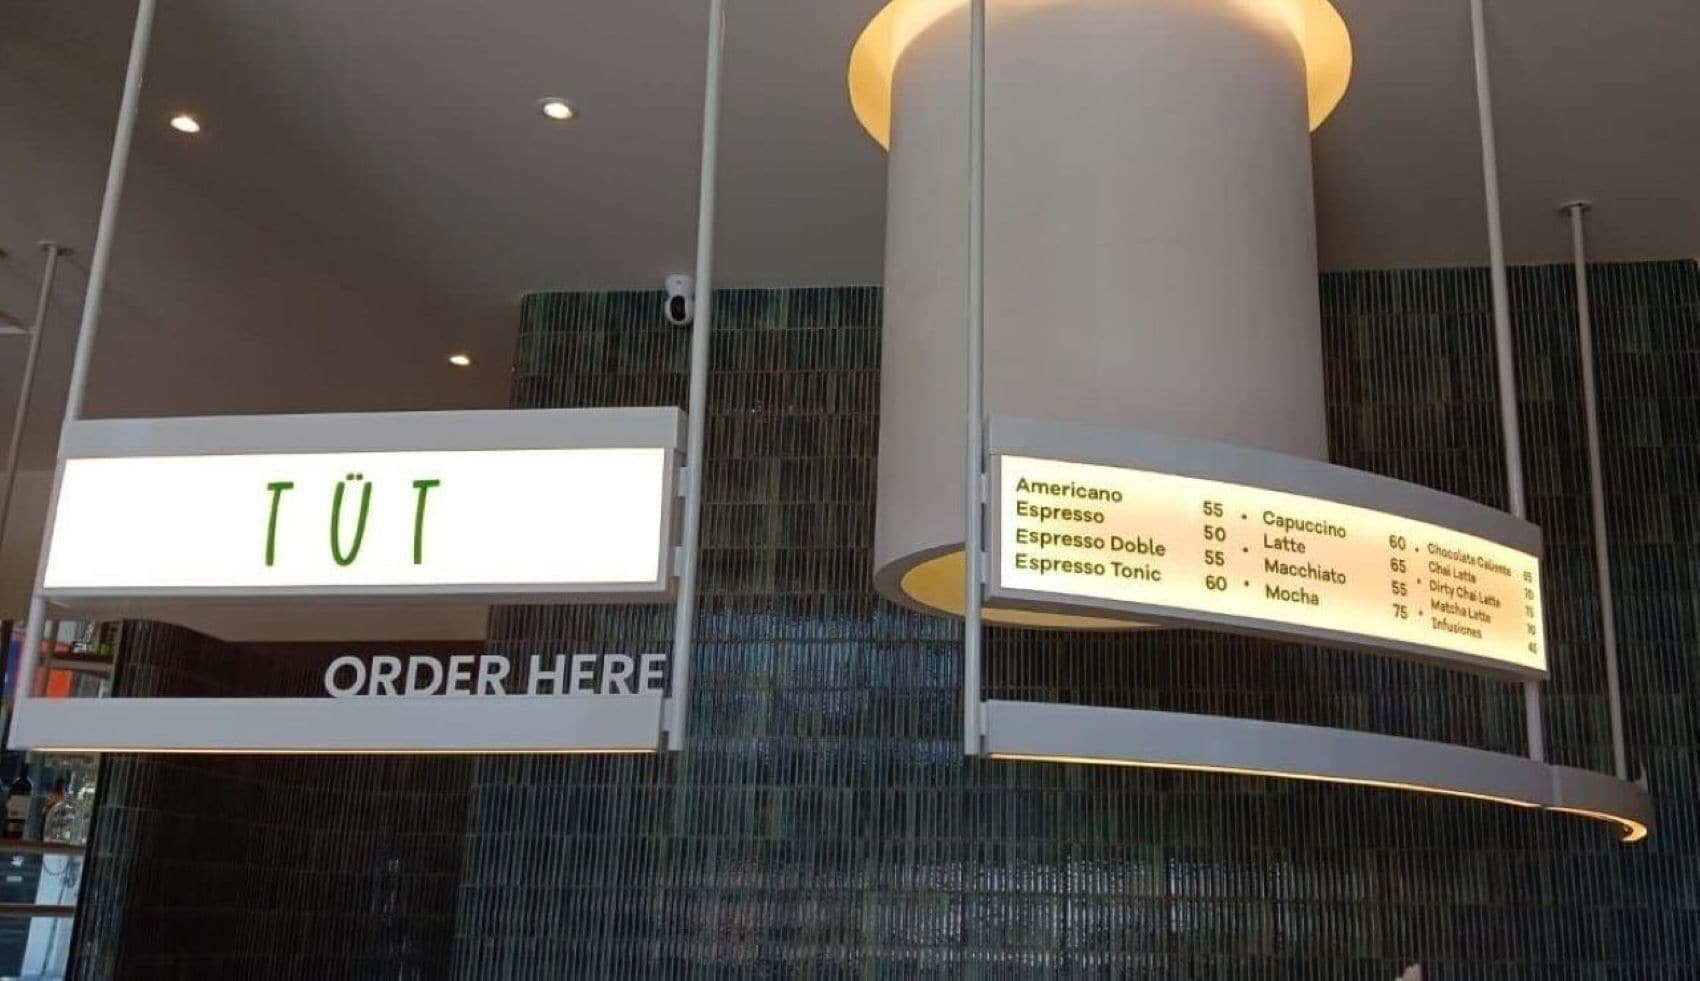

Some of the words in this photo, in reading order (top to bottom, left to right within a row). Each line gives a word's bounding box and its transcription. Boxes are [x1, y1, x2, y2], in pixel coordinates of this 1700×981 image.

[1016, 477, 1123, 503] Americano
[1203, 501, 1223, 517] 55
[1016, 501, 1105, 524] Espresso
[1204, 525, 1226, 542] 50
[1263, 510, 1346, 538] Capuccino
[1389, 534, 1406, 551] 60
[1016, 528, 1105, 549] Espresso
[1111, 535, 1166, 557] Doble
[1205, 550, 1225, 566] 55
[1264, 533, 1306, 554] Latte
[1390, 558, 1406, 574] 65
[1427, 543, 1476, 566] Chocolate
[1015, 553, 1105, 575] Espresso
[1111, 561, 1162, 582] Tonic
[1206, 575, 1227, 591] 60
[1264, 558, 1346, 585] Macchiato
[1391, 580, 1407, 597] 55
[1429, 560, 1451, 577] Chai
[1453, 567, 1477, 584] Latte
[1265, 584, 1319, 606] Mocha
[1392, 603, 1409, 619] 75
[1430, 579, 1454, 599] Dirty
[1456, 586, 1477, 601] Chai
[1479, 591, 1500, 609] Latte
[1431, 598, 1467, 617] Matcha
[1469, 607, 1491, 624] Latte
[324, 655, 510, 698] ORDER
[527, 653, 667, 697] HERE
